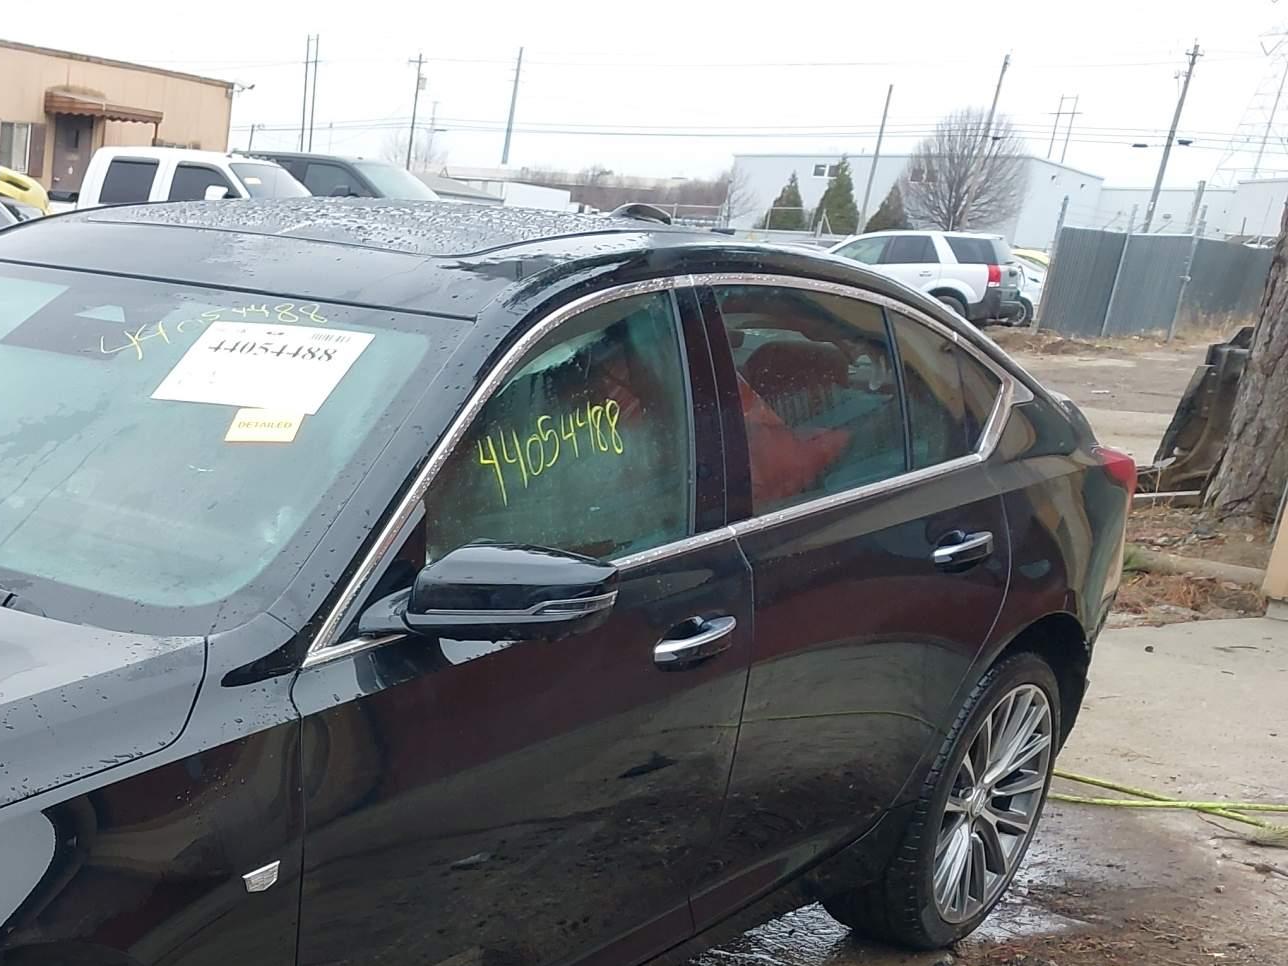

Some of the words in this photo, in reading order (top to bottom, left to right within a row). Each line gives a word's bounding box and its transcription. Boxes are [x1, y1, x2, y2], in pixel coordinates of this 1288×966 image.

[208, 339, 337, 362] 44054488
[237, 421, 293, 430] DETAILED
[477, 399, 624, 507] 44054488
